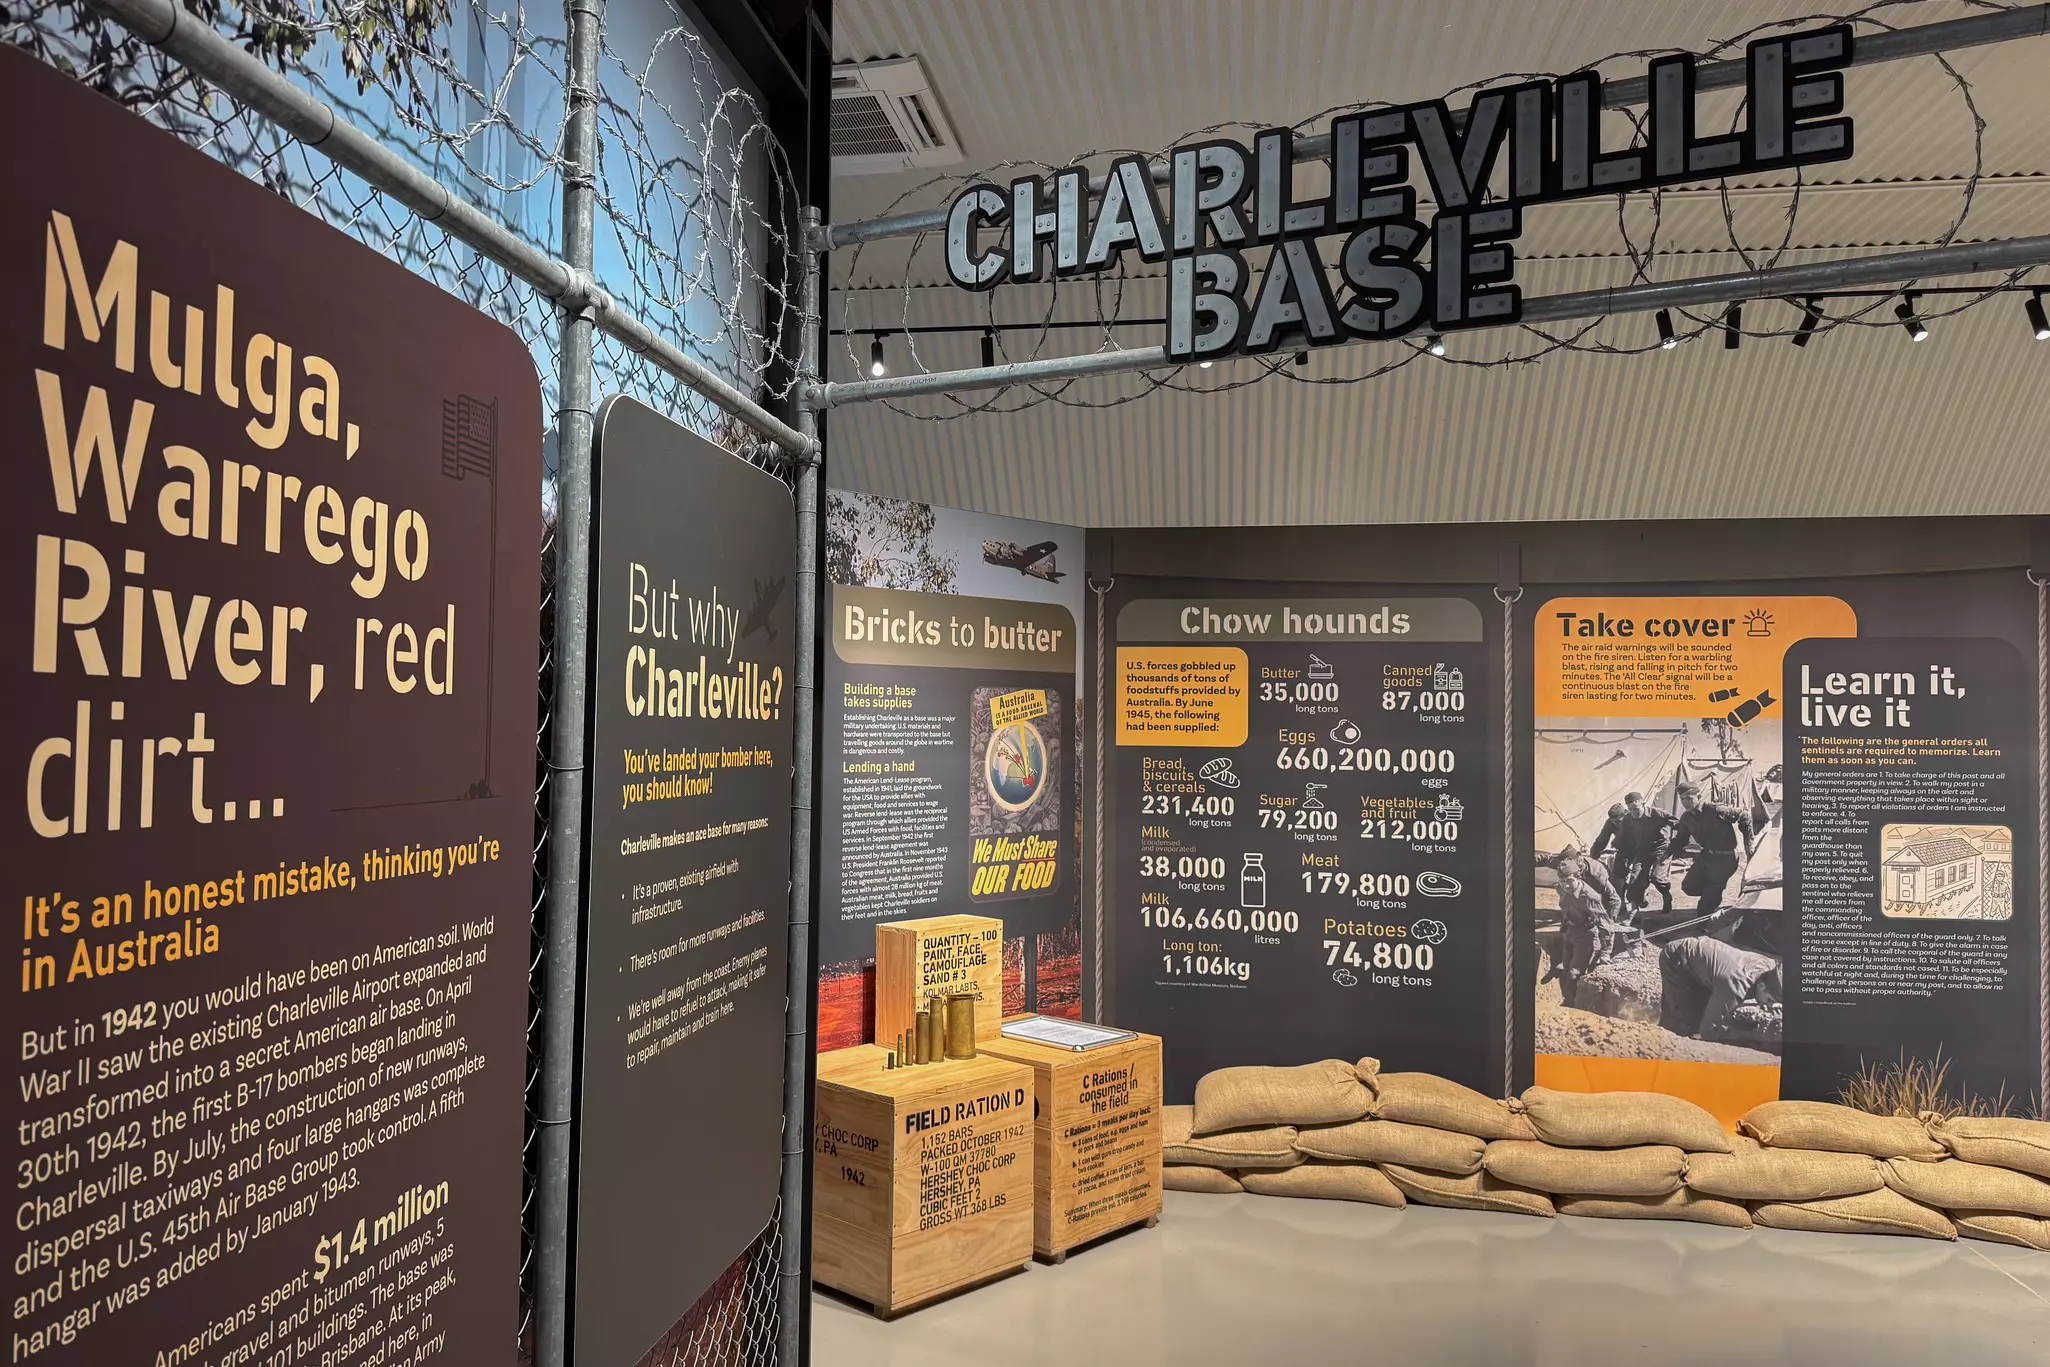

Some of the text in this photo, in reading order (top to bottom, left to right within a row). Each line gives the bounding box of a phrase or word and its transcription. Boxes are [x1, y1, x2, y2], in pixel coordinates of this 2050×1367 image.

[944, 23, 1855, 294] CHARLEVILLE
[1164, 201, 1523, 365] BASE
[43, 210, 359, 460] Mulga,
[35, 368, 428, 599] Warrego
[33, 534, 454, 703] River, red
[629, 562, 739, 664] But why
[1181, 607, 1410, 634] Chow hounds
[845, 606, 1062, 651] Bricks to butter
[1557, 613, 1735, 637] Take cover
[1562, 643, 1731, 653] The air raid warnings will be sounded
[1147, 661, 1178, 670] forces
[1180, 661, 1220, 672] gobbled
[1223, 664, 1236, 672] up
[1262, 668, 1301, 678] Butter
[1383, 665, 1431, 675] Canned
[626, 645, 782, 720] Charleville?
[845, 683, 916, 698] Building a base
[1384, 676, 1422, 689] goods
[1801, 665, 1965, 699] Learn it,
[844, 696, 912, 710] takes supplies
[1000, 692, 1035, 711] Australia
[1260, 683, 1338, 703] 35,000
[1383, 691, 1464, 712] 87,000
[1295, 704, 1339, 714] long tons
[1419, 714, 1465, 724] long tons
[1802, 697, 1910, 727] live it
[1280, 729, 1315, 745] Eggs
[624, 746, 772, 774] You've landed your bomber here,
[1277, 748, 1454, 774] 660,200,000
[1865, 748, 1904, 756] required
[1973, 748, 2000, 756] Learn
[27, 700, 283, 837] dirt...
[844, 761, 914, 774] Lending a hand
[1144, 757, 1185, 769] Bread,
[1143, 769, 1194, 781] biscuits
[1422, 778, 1448, 788] eggs
[623, 772, 712, 809] you should know!
[1143, 781, 1205, 793] & cereals
[1142, 795, 1234, 817] 231,400
[1260, 795, 1297, 808] Sugar
[1361, 796, 1433, 810] Vegetables
[1189, 818, 1209, 829] long
[1259, 810, 1337, 831] 79,200
[1361, 808, 1416, 819] and fruit
[621, 833, 661, 855] Charleville
[662, 830, 685, 847] makes
[686, 831, 694, 842] an
[695, 829, 706, 840] ace
[708, 824, 721, 838] base
[723, 821, 731, 835] for
[732, 822, 747, 835] many
[1142, 826, 1169, 838] Milk
[1361, 819, 1457, 841] 212,000
[972, 834, 1058, 864] We Must Share
[1302, 853, 1339, 866] Meat
[1140, 856, 1225, 879] 38,000
[25, 835, 499, 940] It's an honest mistake, thinking you're
[971, 861, 1056, 896] OUR FOOD
[1302, 872, 1409, 897] 179,800
[1142, 893, 1169, 905] Milk
[1141, 907, 1298, 933] 106,660,000
[1325, 919, 1406, 937] Potatoes
[923, 930, 997, 949] QUANTITY 100
[1164, 939, 1221, 953] Long ton:
[1255, 935, 1280, 944] litres
[22, 918, 219, 992] in Australia
[923, 954, 987, 974] CAMOUFLAGE
[1324, 940, 1433, 970] 74,800
[923, 972, 950, 986] SAND
[961, 969, 966, 979] 3
[1164, 955, 1249, 980] 1,106kg
[22, 916, 493, 1060] But in 1942 you would have been on American soil. World
[1373, 973, 1431, 987] long tons
[923, 985, 954, 998] KOLMAR
[1083, 1069, 1127, 1089] C Rations
[1080, 1079, 1137, 1104] consumed in
[906, 1089, 1024, 1134] FIELD RATION D
[1092, 1092, 1129, 1114] the field
[822, 1124, 879, 1152] CHOC CORP
[921, 1125, 1024, 1163] PACKED OCTOBER 1942
[841, 1166, 865, 1186] 1942
[921, 1153, 1015, 1190] HERSHEY CHOC CORP
[314, 1181, 448, 1286] $1.4 million
